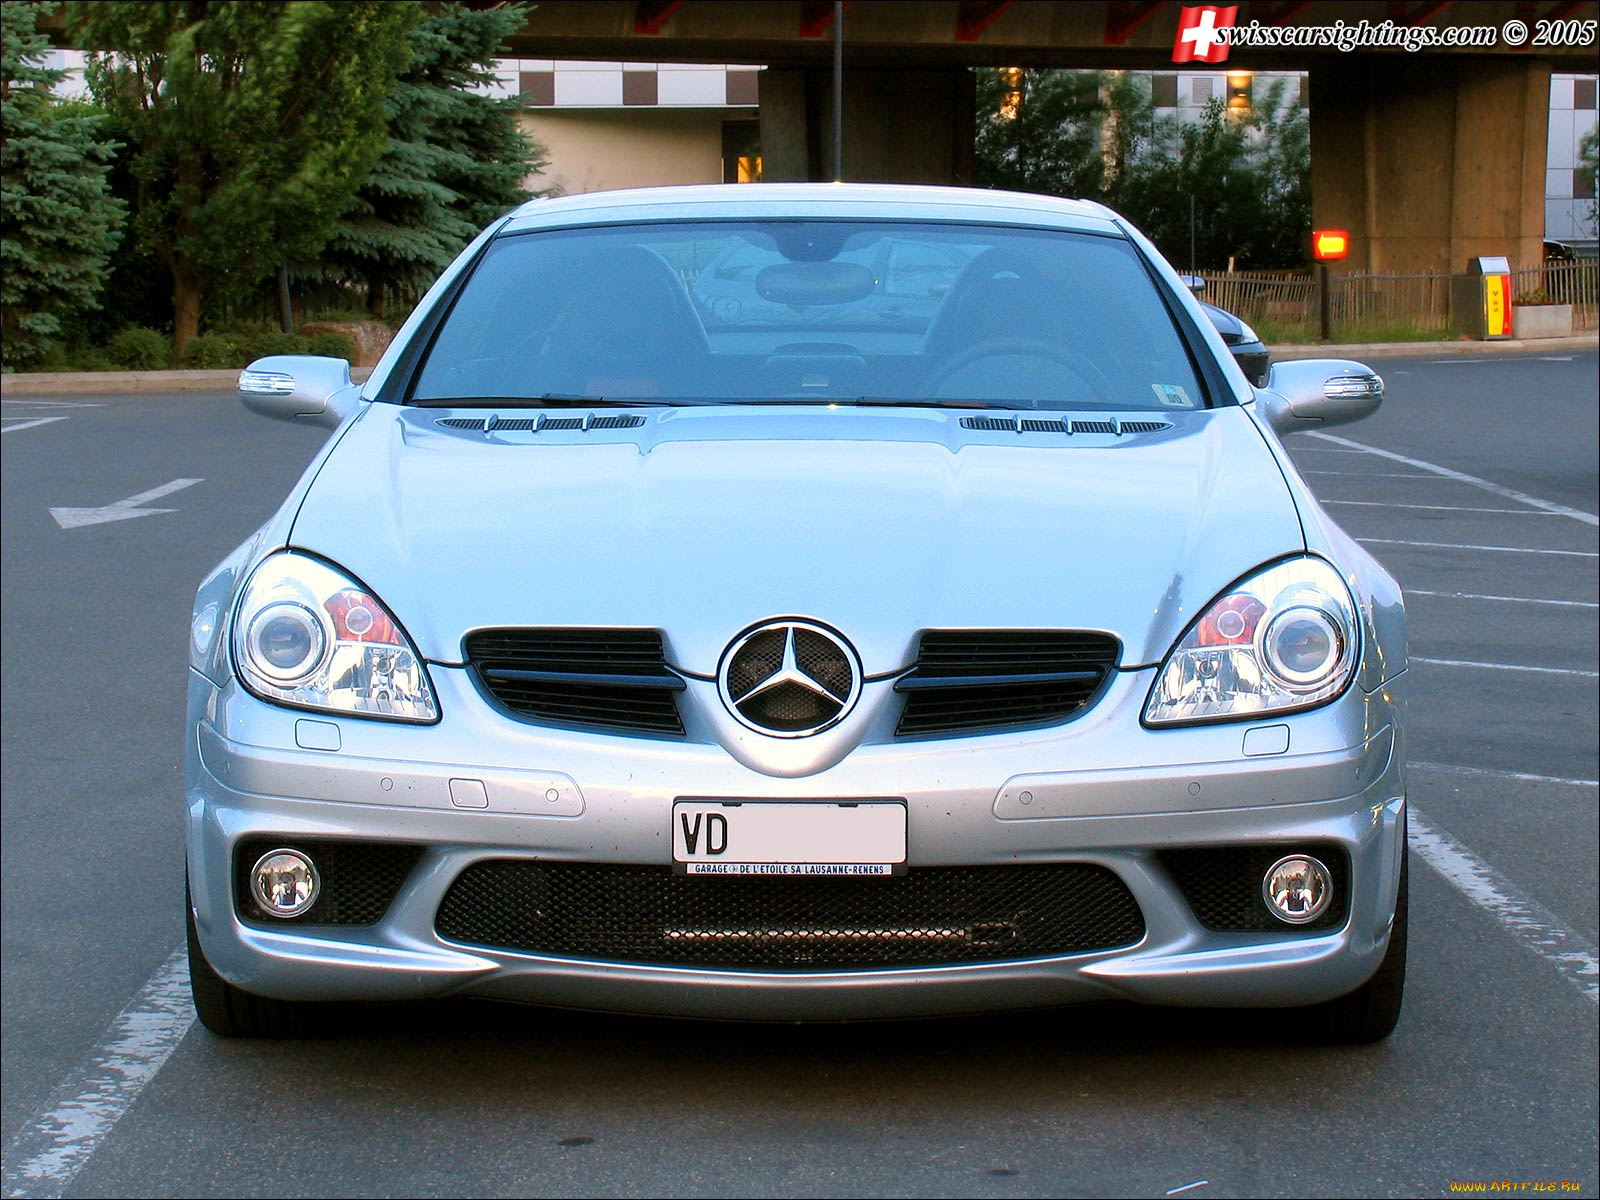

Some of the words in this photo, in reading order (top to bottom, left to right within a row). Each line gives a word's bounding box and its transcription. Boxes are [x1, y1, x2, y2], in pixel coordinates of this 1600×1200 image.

[681, 812, 728, 855] VD
[695, 864, 728, 874] GARAGE
[740, 864, 750, 874] DE
[753, 864, 788, 874] L'ETOILE
[790, 864, 802, 874] SA
